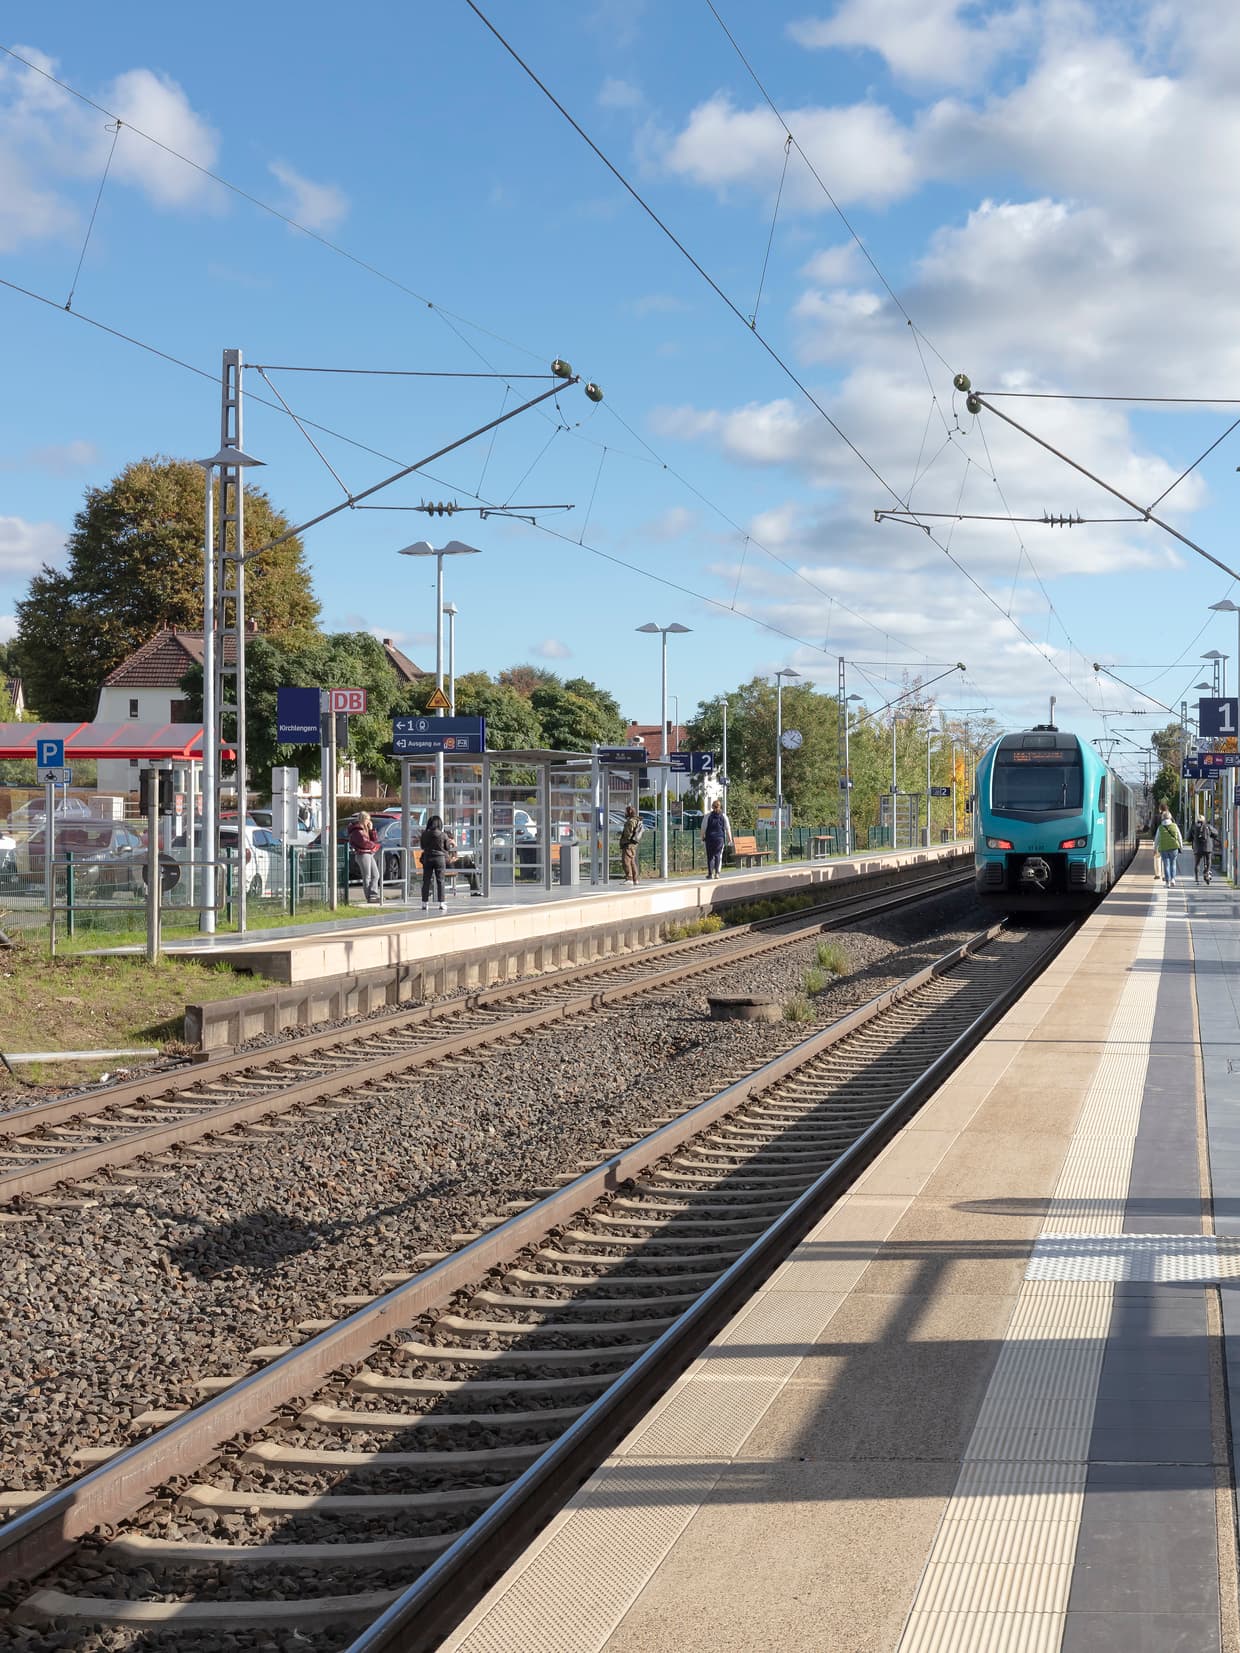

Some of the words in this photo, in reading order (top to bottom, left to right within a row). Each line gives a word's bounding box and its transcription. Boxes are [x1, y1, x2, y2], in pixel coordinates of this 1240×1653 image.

[334, 692, 362, 710] DB
[407, 720, 414, 731] 1
[1218, 702, 1235, 732] 1
[279, 724, 318, 733] Kirchlengern
[43, 743, 58, 764] P
[701, 754, 712, 770] 2
